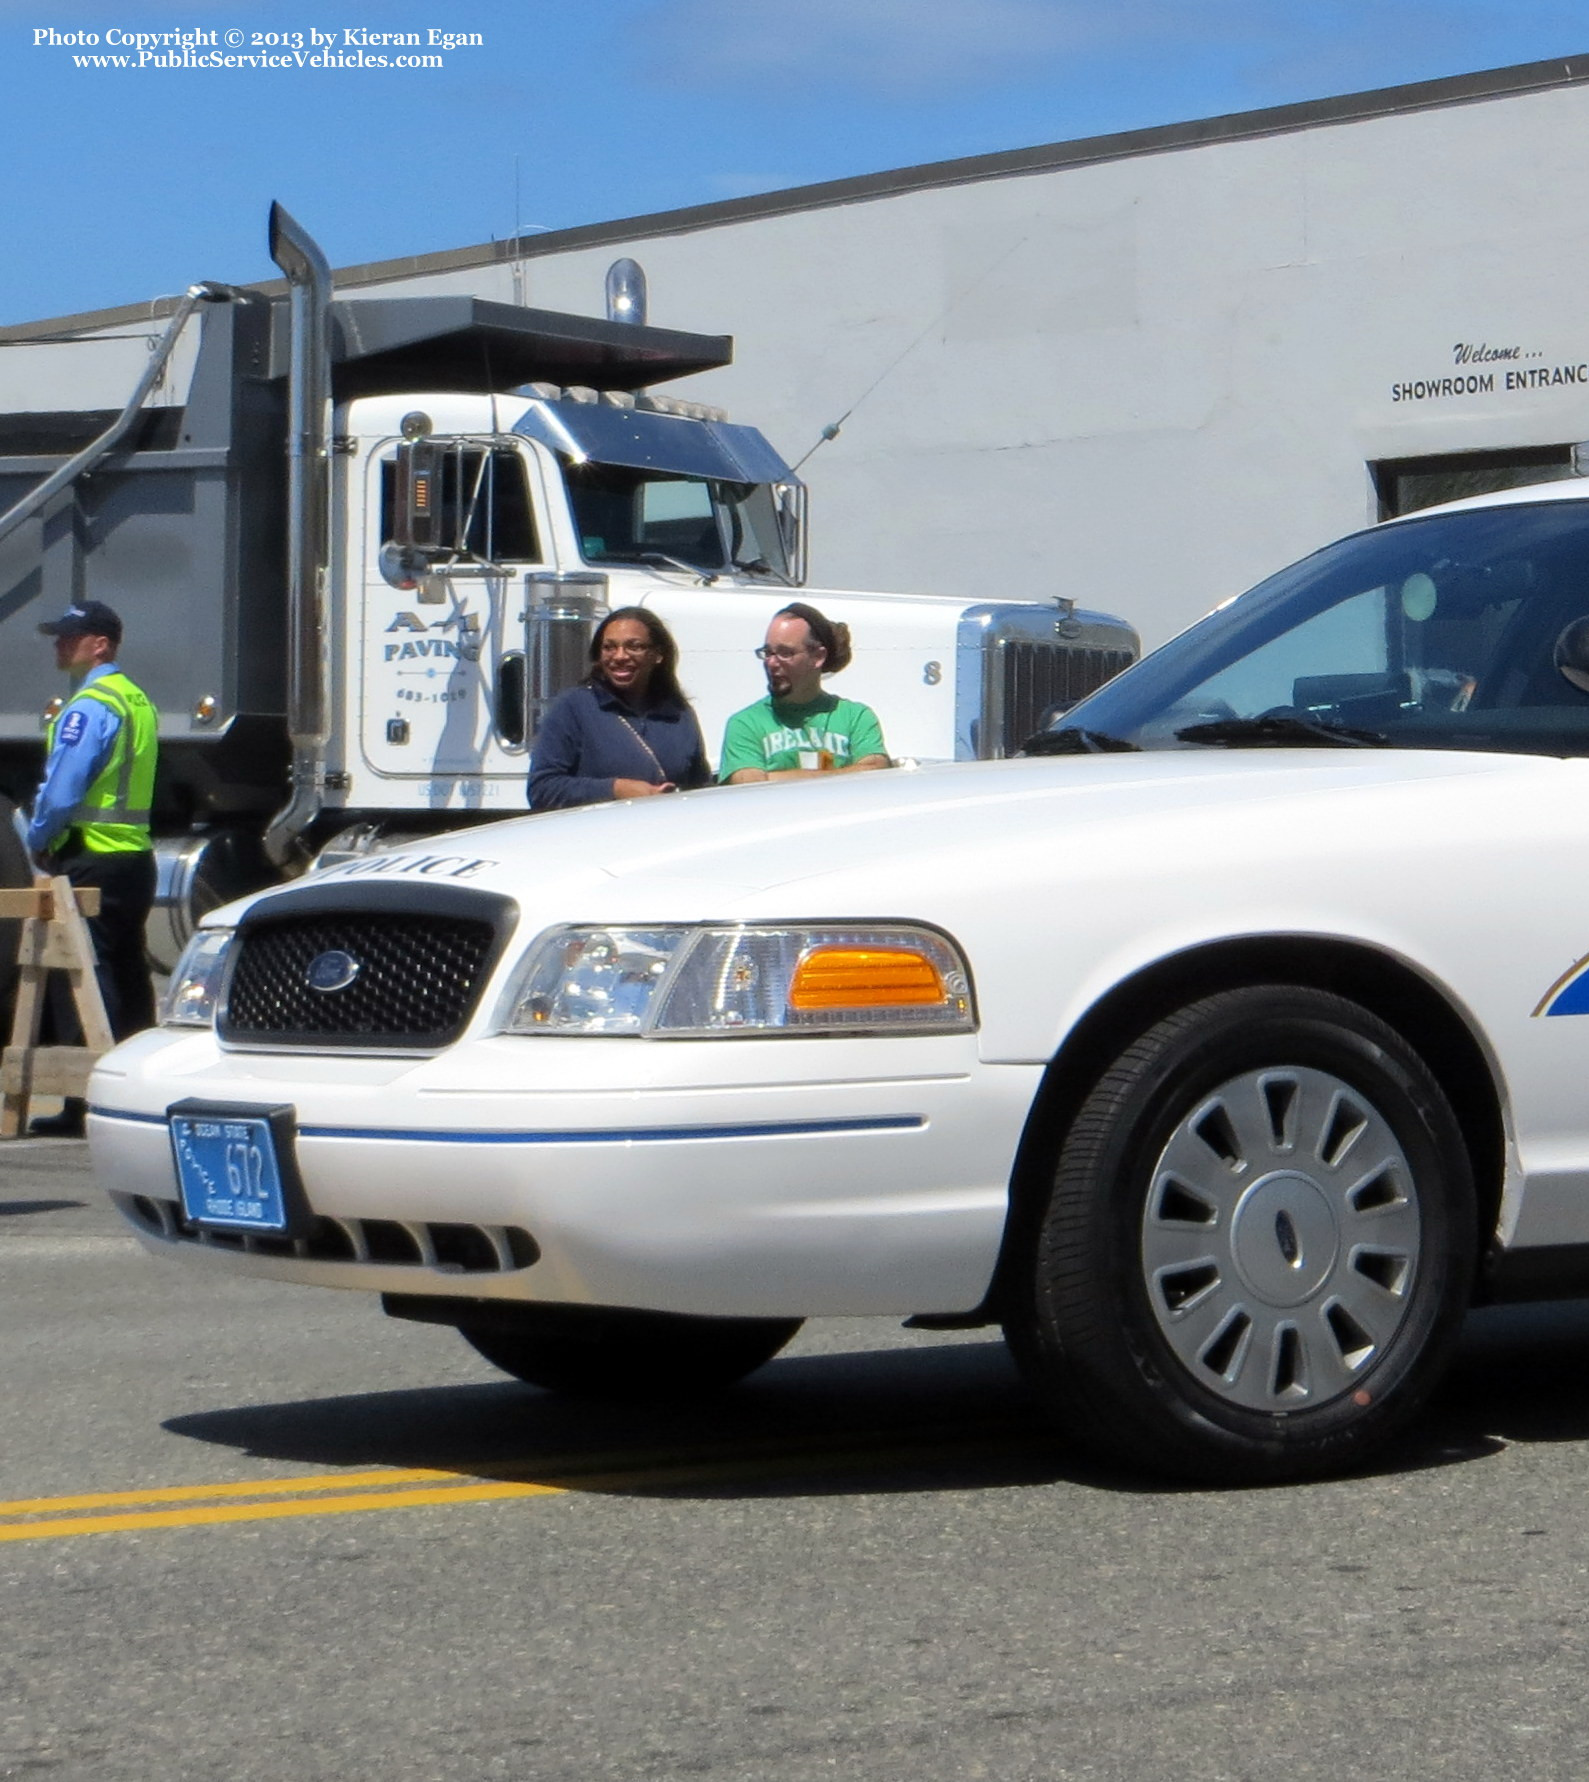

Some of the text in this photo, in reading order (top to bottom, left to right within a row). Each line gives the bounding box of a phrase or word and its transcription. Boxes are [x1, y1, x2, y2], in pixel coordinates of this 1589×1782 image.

[1392, 373, 1494, 402] SHOWROOM
[384, 639, 480, 662] PAVING
[923, 660, 942, 686] 8
[227, 1143, 269, 1198] 672
